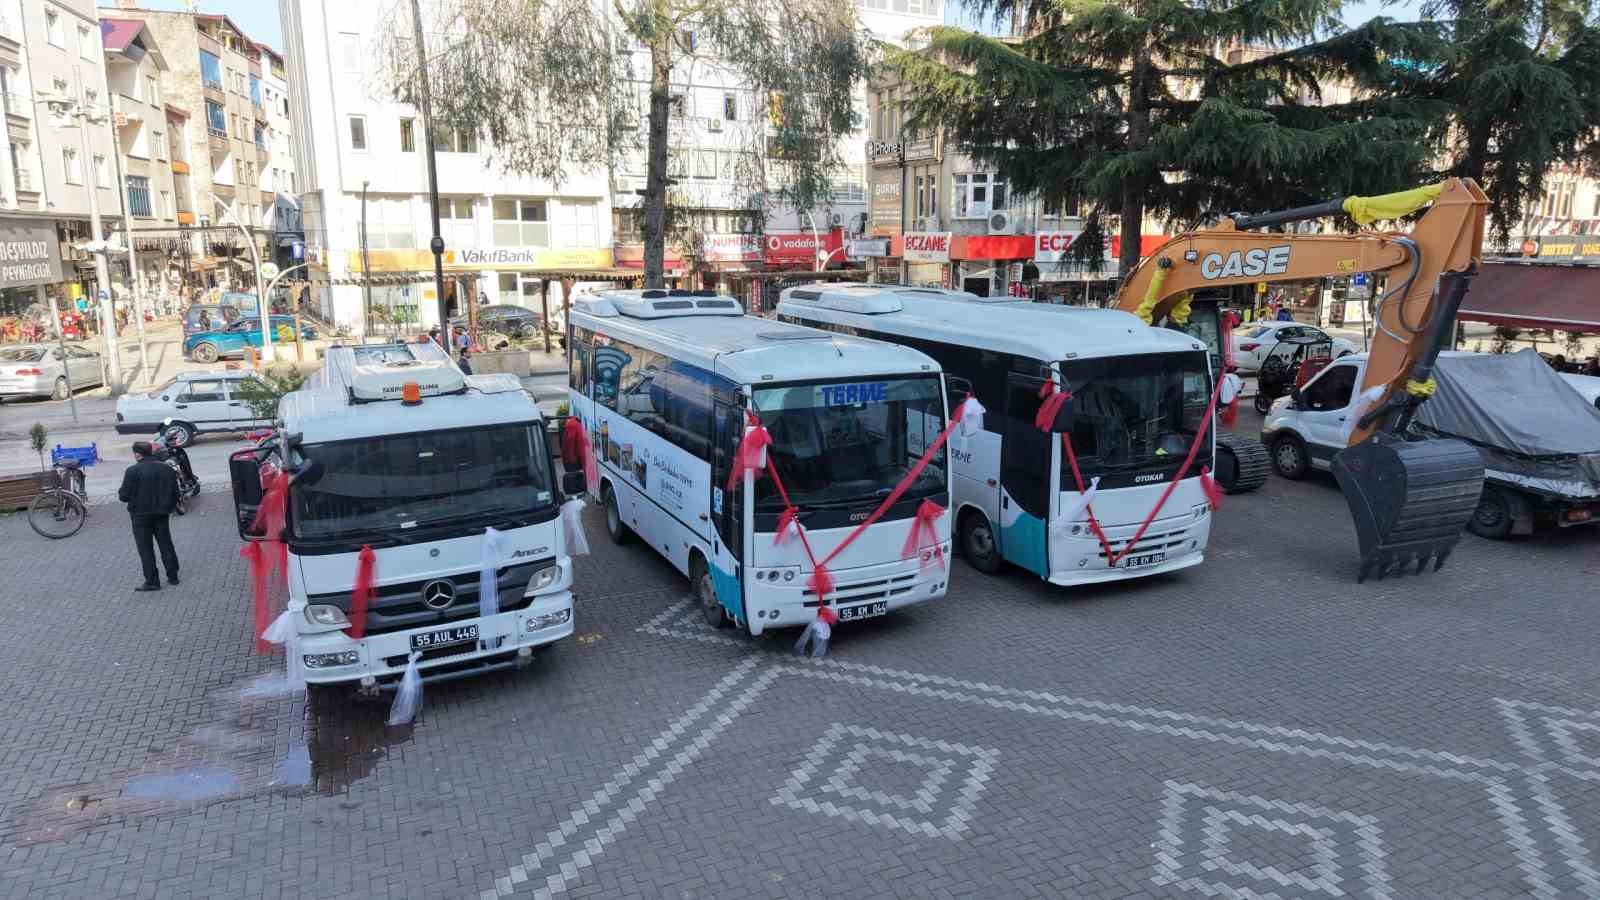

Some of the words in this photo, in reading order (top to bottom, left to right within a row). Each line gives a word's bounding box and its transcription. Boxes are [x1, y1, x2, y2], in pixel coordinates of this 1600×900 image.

[905, 235, 946, 251] ECZANE
[1201, 245, 1291, 281] CASE
[822, 383, 887, 406] TERME
[1135, 473, 1164, 482] OTOKAR
[842, 608, 853, 618] 55
[416, 633, 430, 646] 55
[433, 630, 453, 644] AUL
[456, 626, 477, 638] 449
